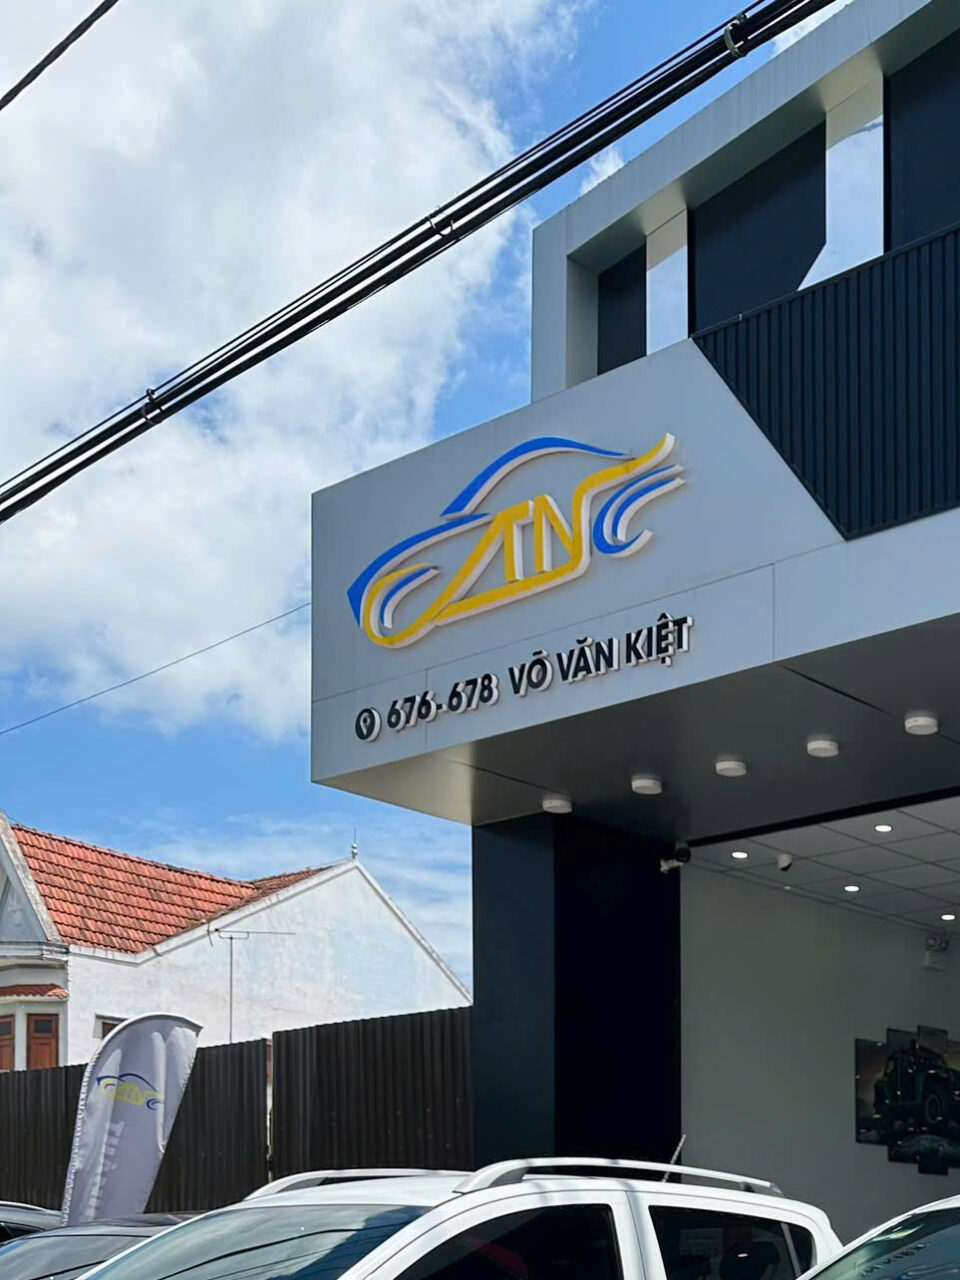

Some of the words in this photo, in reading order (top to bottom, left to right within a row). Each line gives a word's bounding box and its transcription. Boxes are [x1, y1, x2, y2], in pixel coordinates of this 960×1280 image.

[387, 673, 499, 731] 676-678
[508, 649, 554, 697] VÕ
[556, 636, 621, 683] VĂN
[625, 612, 694, 666] KIỆT
